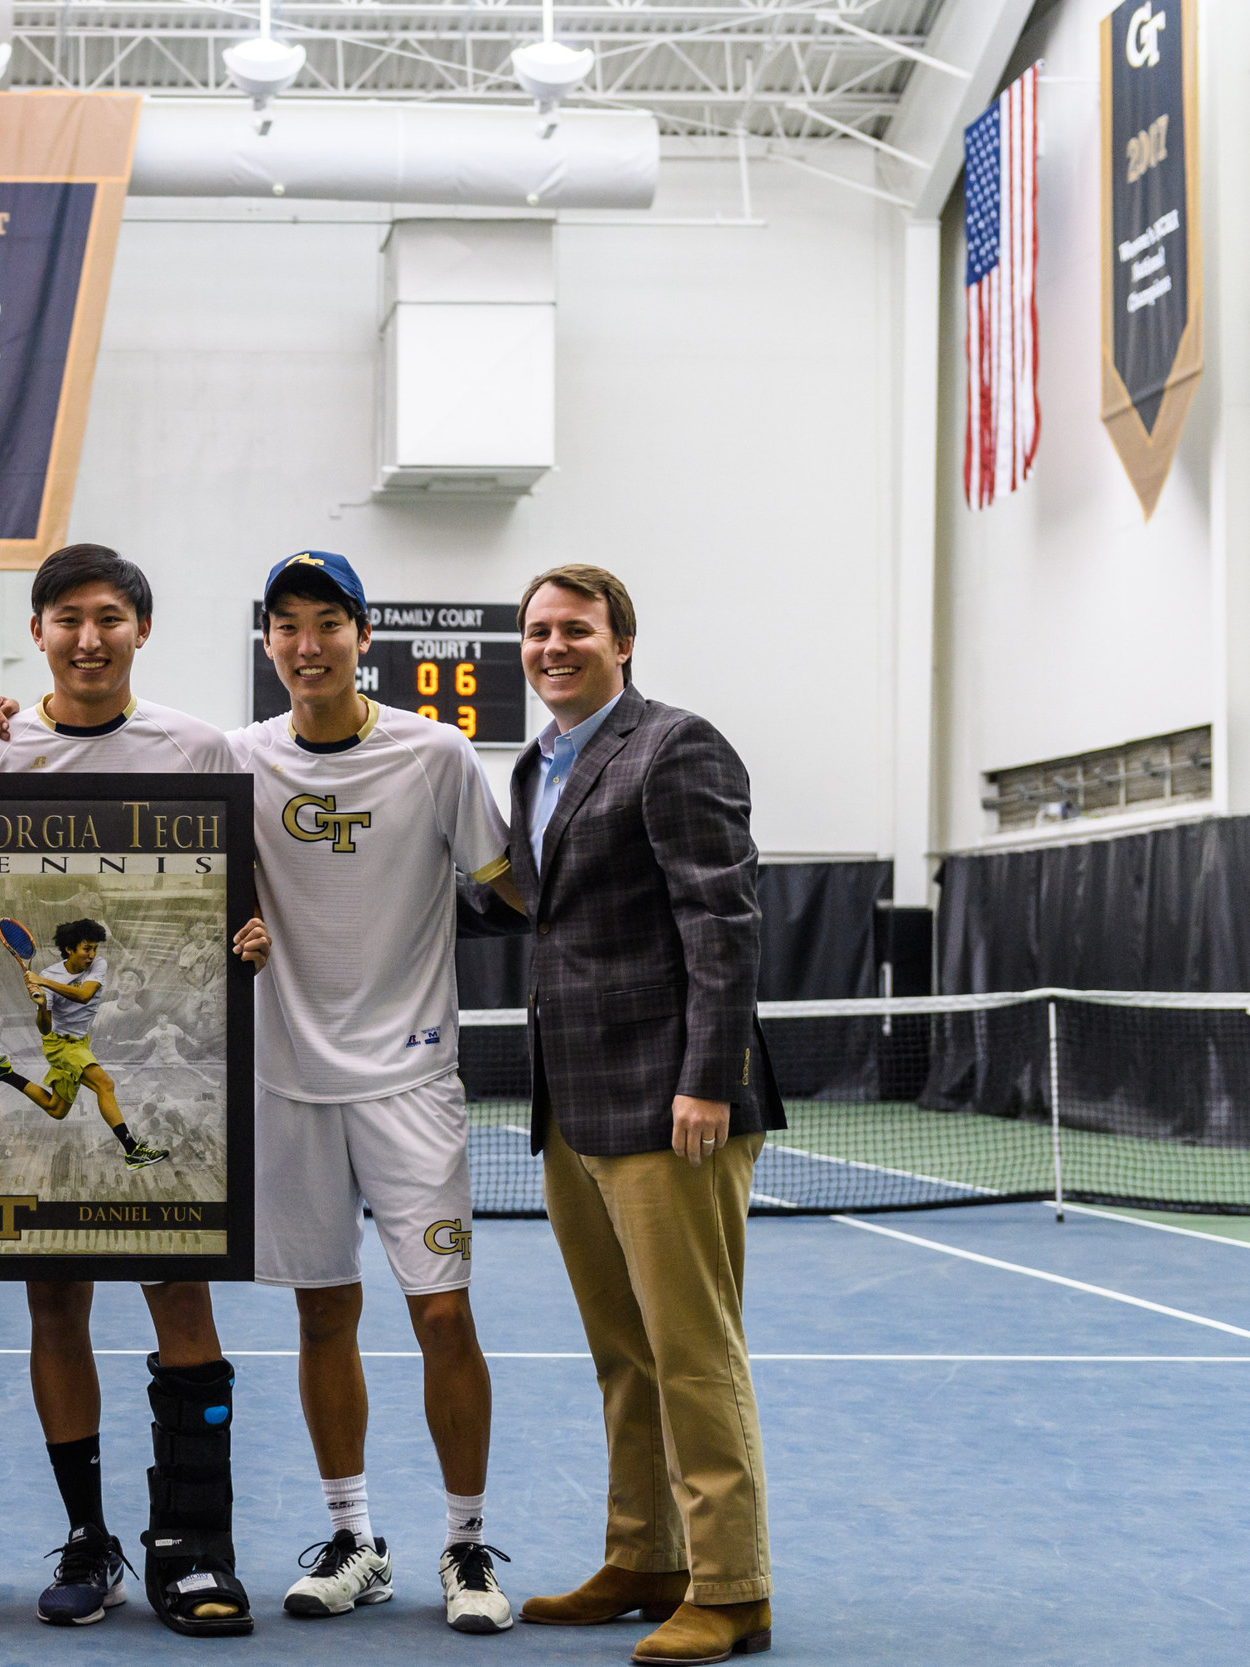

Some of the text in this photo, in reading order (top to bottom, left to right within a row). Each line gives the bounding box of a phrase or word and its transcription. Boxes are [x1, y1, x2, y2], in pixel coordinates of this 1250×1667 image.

[1126, 1, 1166, 68] GT
[384, 608, 434, 626] FAMILY
[438, 608, 484, 627] COURT
[412, 640, 481, 660] COURT 1
[418, 663, 476, 695] 0 6
[457, 705, 477, 738] 3
[282, 793, 371, 853] GT
[79, 1206, 202, 1222] DANIEL YUN
[423, 1218, 472, 1261] GT
